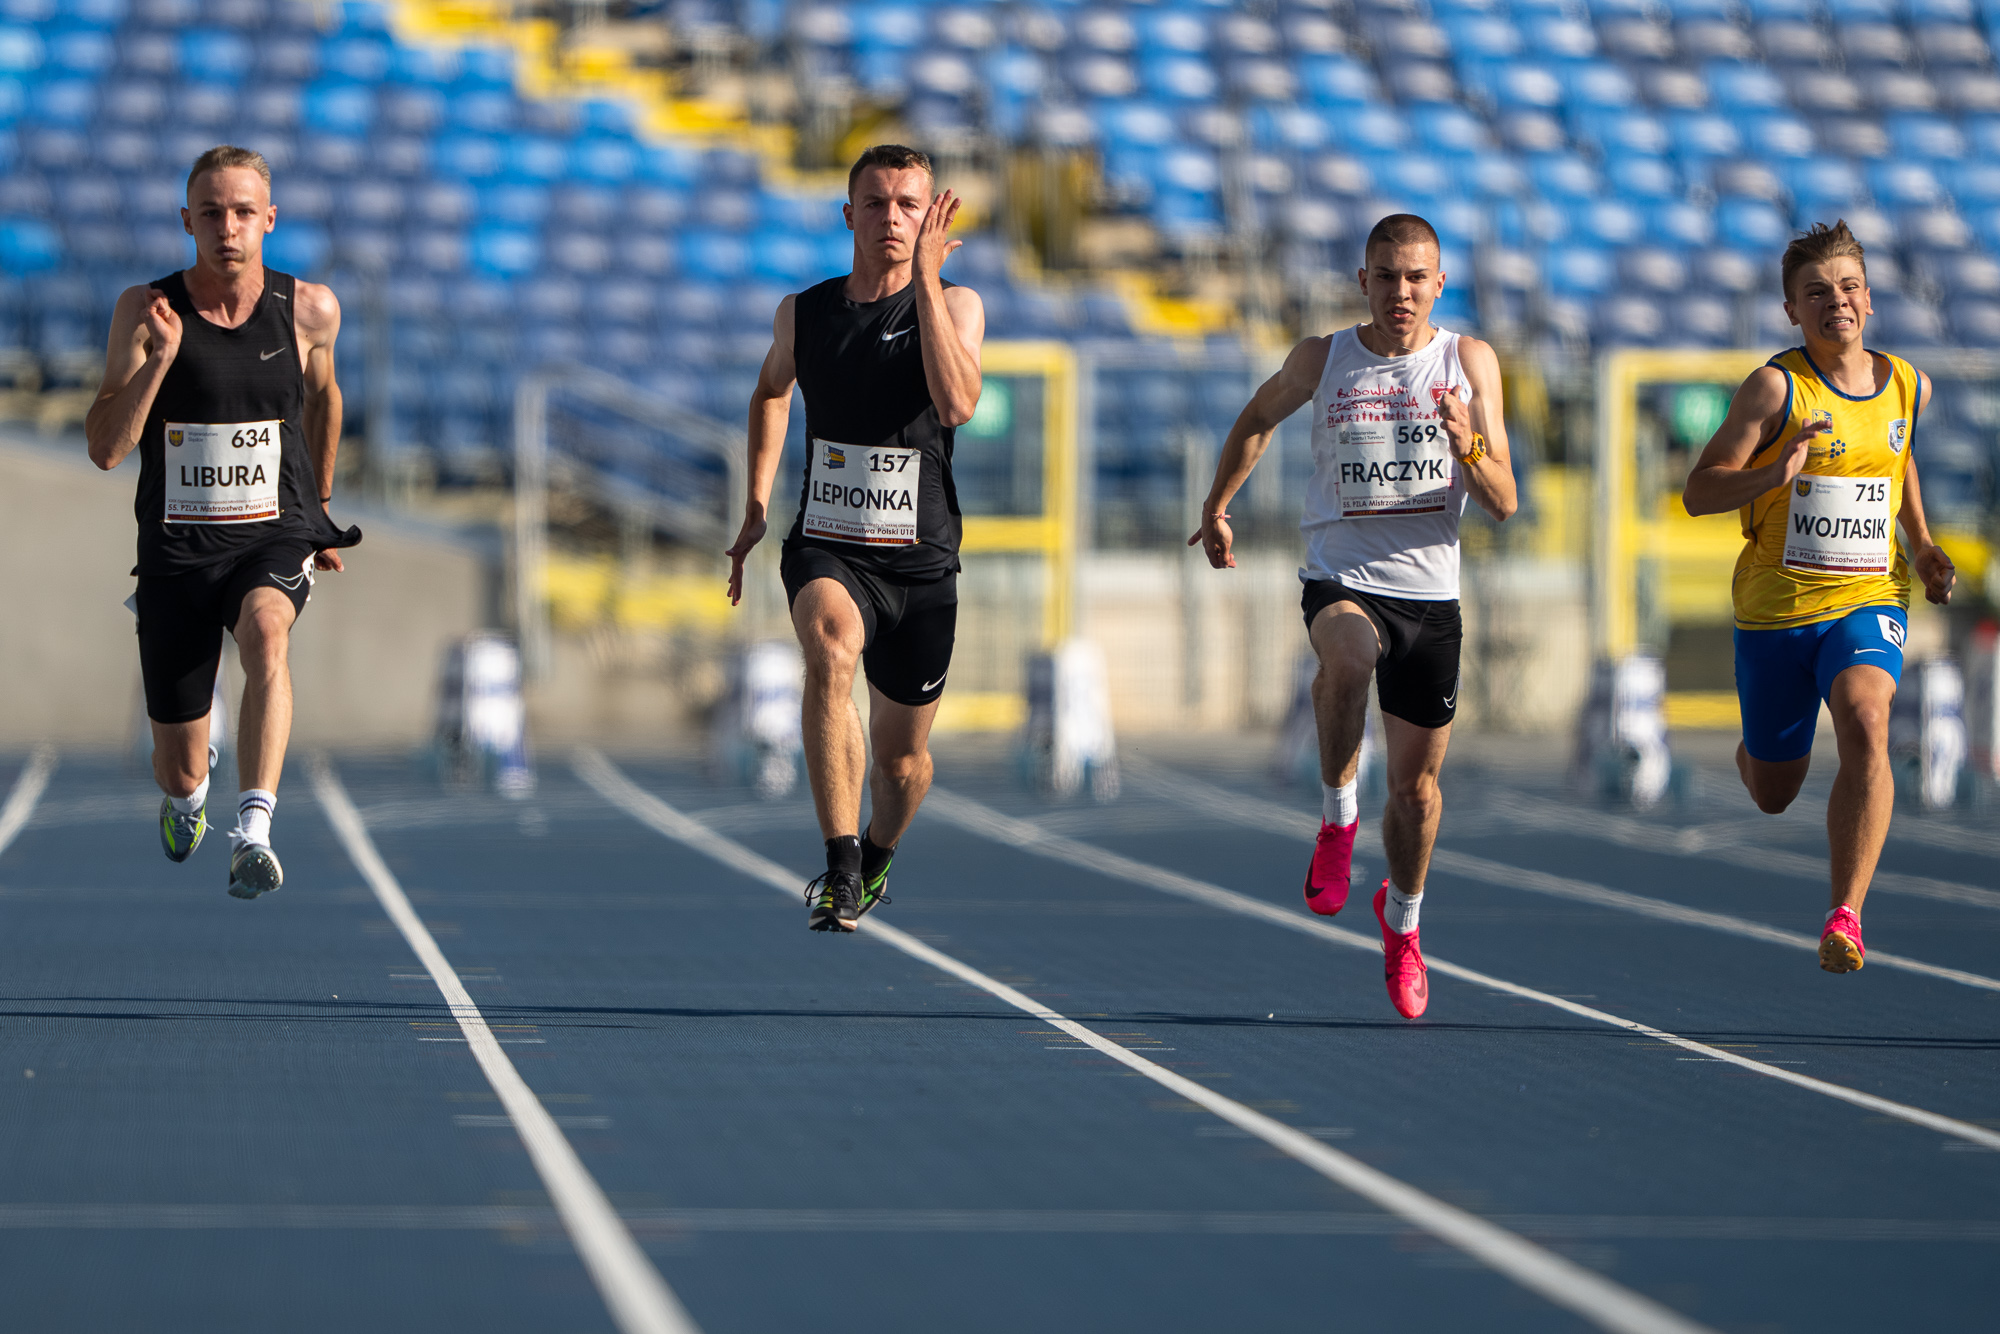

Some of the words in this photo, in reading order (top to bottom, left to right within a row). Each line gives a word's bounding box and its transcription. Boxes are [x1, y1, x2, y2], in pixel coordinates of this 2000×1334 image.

[232, 428, 270, 448] 634
[1398, 425, 1437, 444] 569
[870, 454, 910, 472] 157
[1341, 459, 1444, 486] FRĄCZYK
[181, 464, 266, 487] LIBURA
[813, 480, 912, 510] LEPIONKA
[1856, 484, 1884, 501] 715
[835, 523, 875, 534] Mistrzostwa
[1794, 513, 1886, 539] WOJTASIK
[1800, 552, 1816, 560] PZLA
[1819, 555, 1858, 563] Mistrzostwa
[1889, 620, 1902, 648] 5
